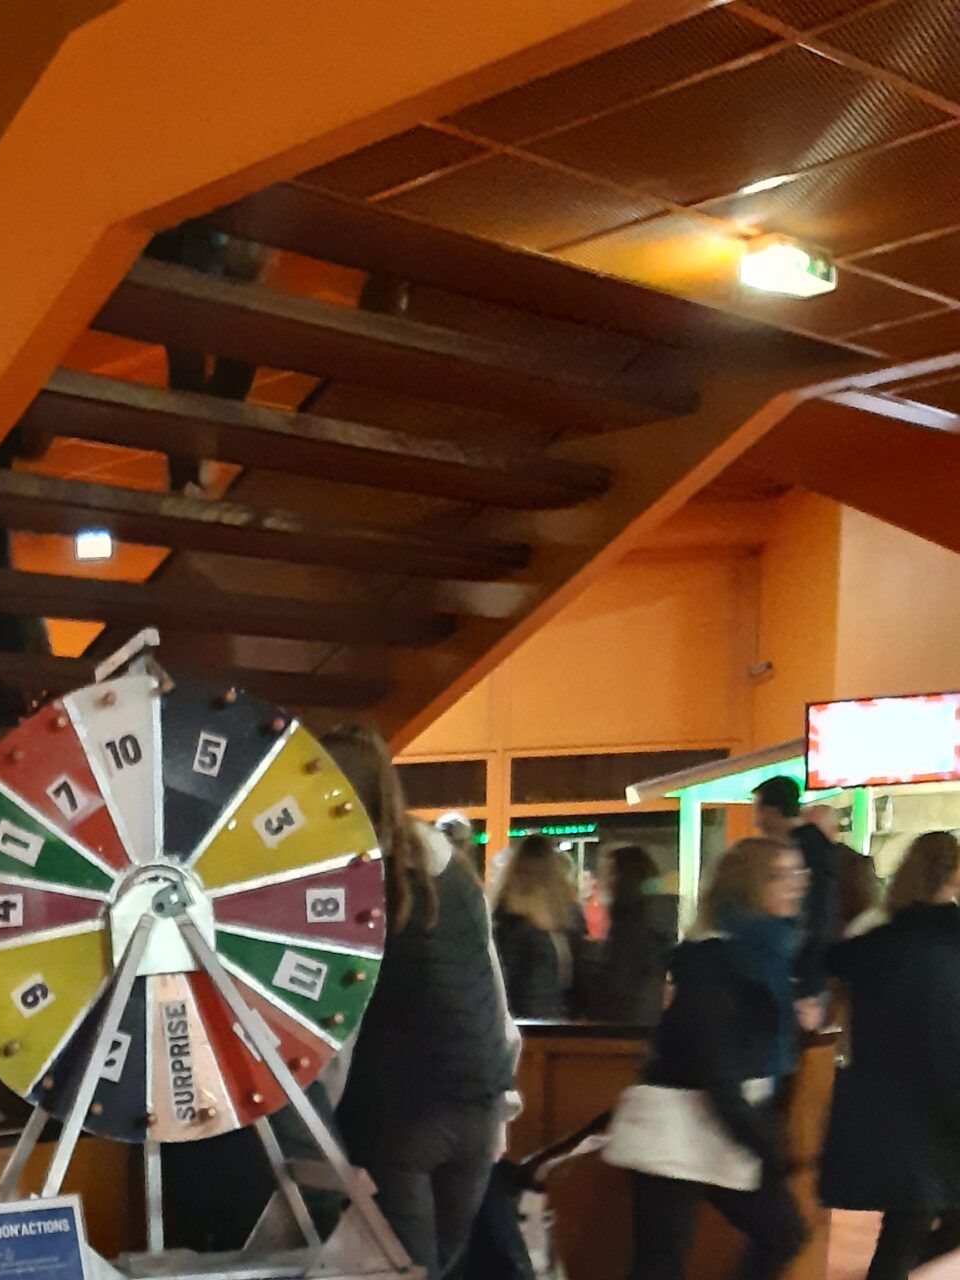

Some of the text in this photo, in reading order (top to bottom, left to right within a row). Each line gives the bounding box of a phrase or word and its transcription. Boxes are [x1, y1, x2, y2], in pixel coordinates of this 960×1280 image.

[106, 735, 143, 768] 10
[198, 741, 221, 771] 5
[53, 782, 80, 811] 7
[265, 807, 295, 836] 3
[1, 833, 30, 852] 1
[311, 896, 340, 917] 8
[288, 961, 323, 991] 11
[165, 1003, 196, 1120] SURPRISE
